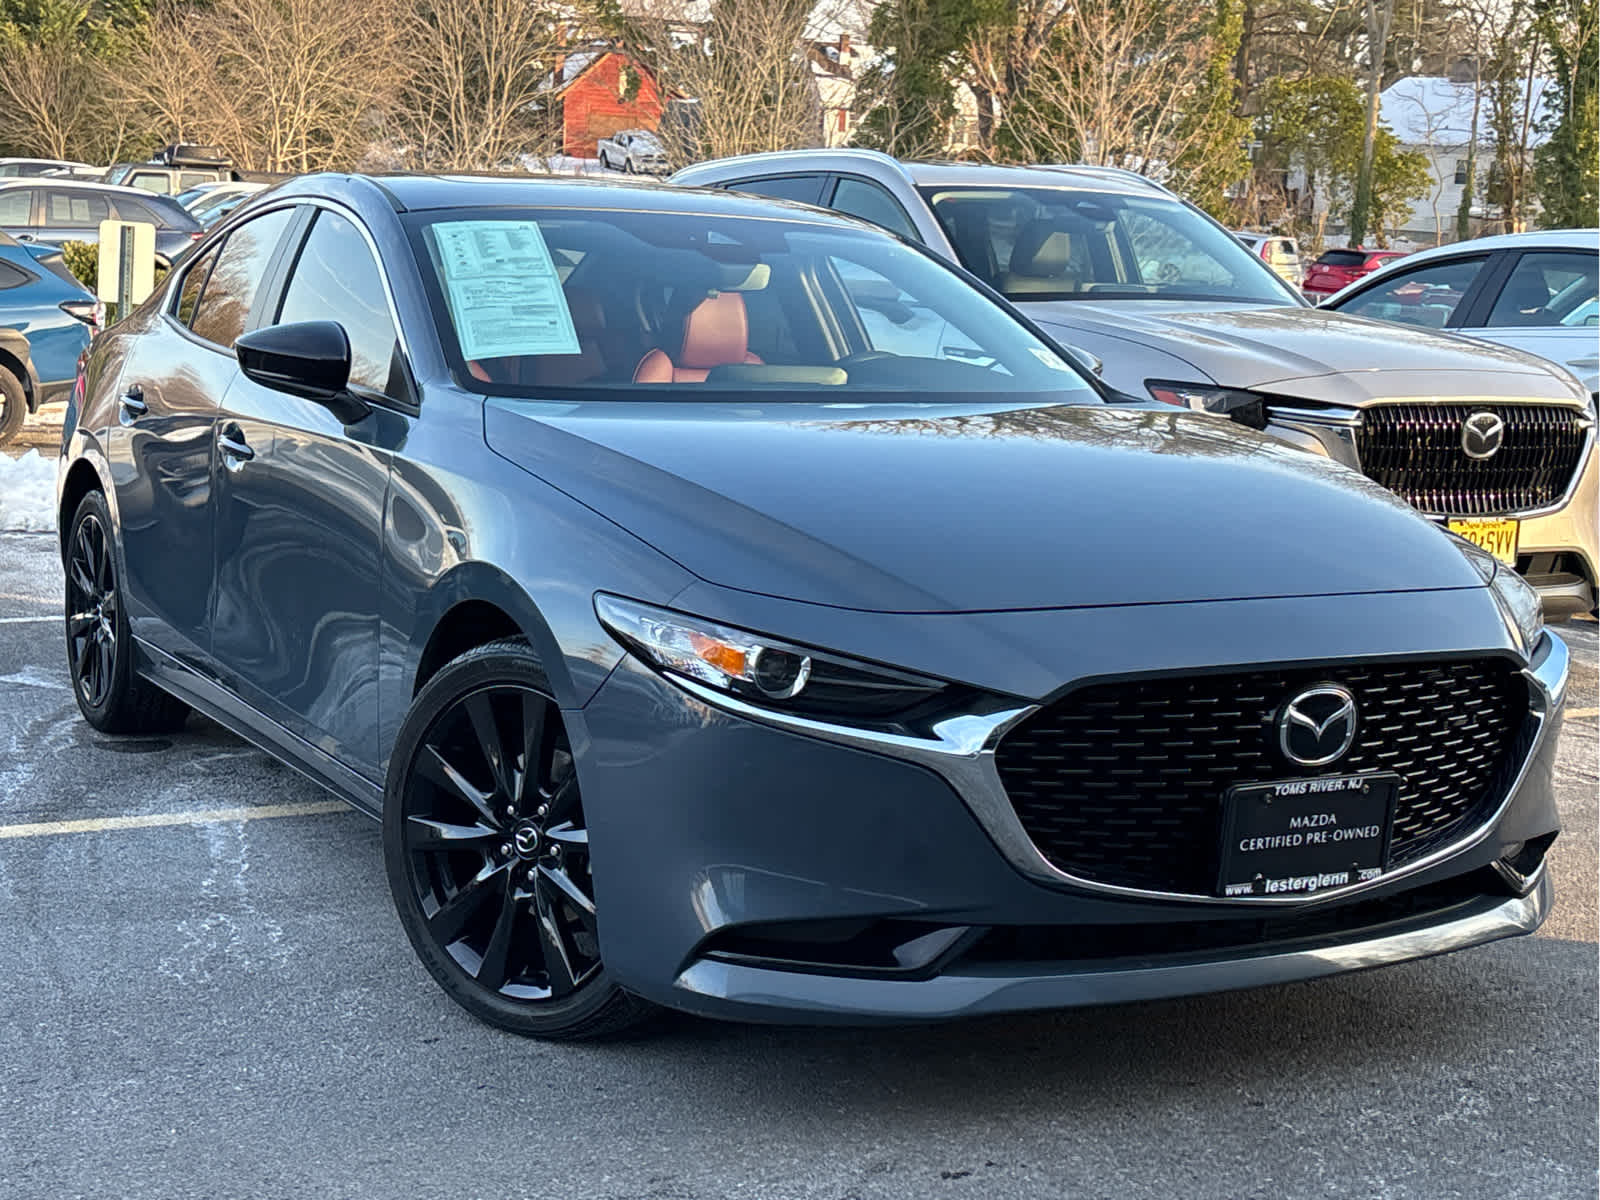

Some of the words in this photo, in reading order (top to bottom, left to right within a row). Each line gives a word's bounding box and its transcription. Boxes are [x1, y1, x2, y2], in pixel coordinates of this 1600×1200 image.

[1274, 784, 1307, 796] TOMS
[1347, 777, 1363, 789] NJ
[1289, 813, 1337, 829] MAZDA
[1239, 834, 1302, 852] CERTIFIED
[1306, 825, 1380, 845] PRE-OWNED
